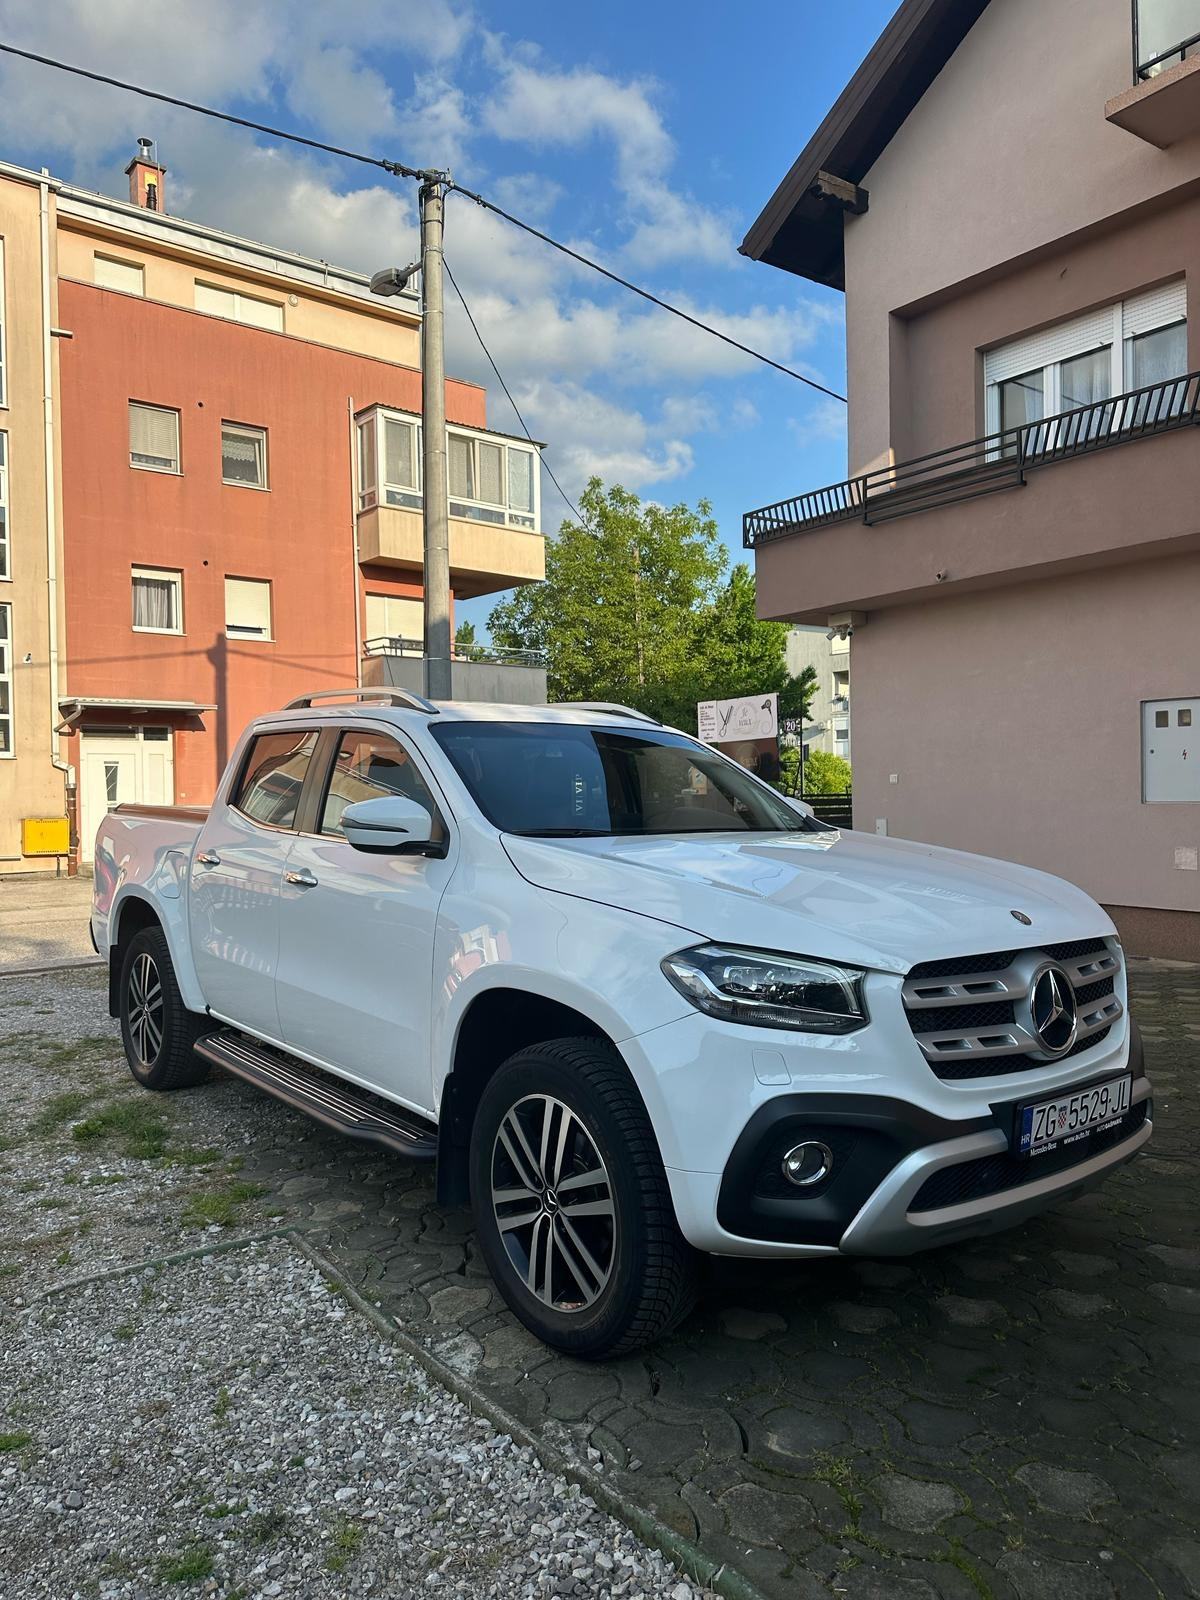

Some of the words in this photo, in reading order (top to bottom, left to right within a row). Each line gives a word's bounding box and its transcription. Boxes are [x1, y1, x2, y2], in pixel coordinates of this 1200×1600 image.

[786, 721, 796, 731] 20
[1033, 1104, 1057, 1142] ZG
[1021, 1133, 1031, 1145] HR
[1030, 1142, 1057, 1157] Mercedes-Benz
